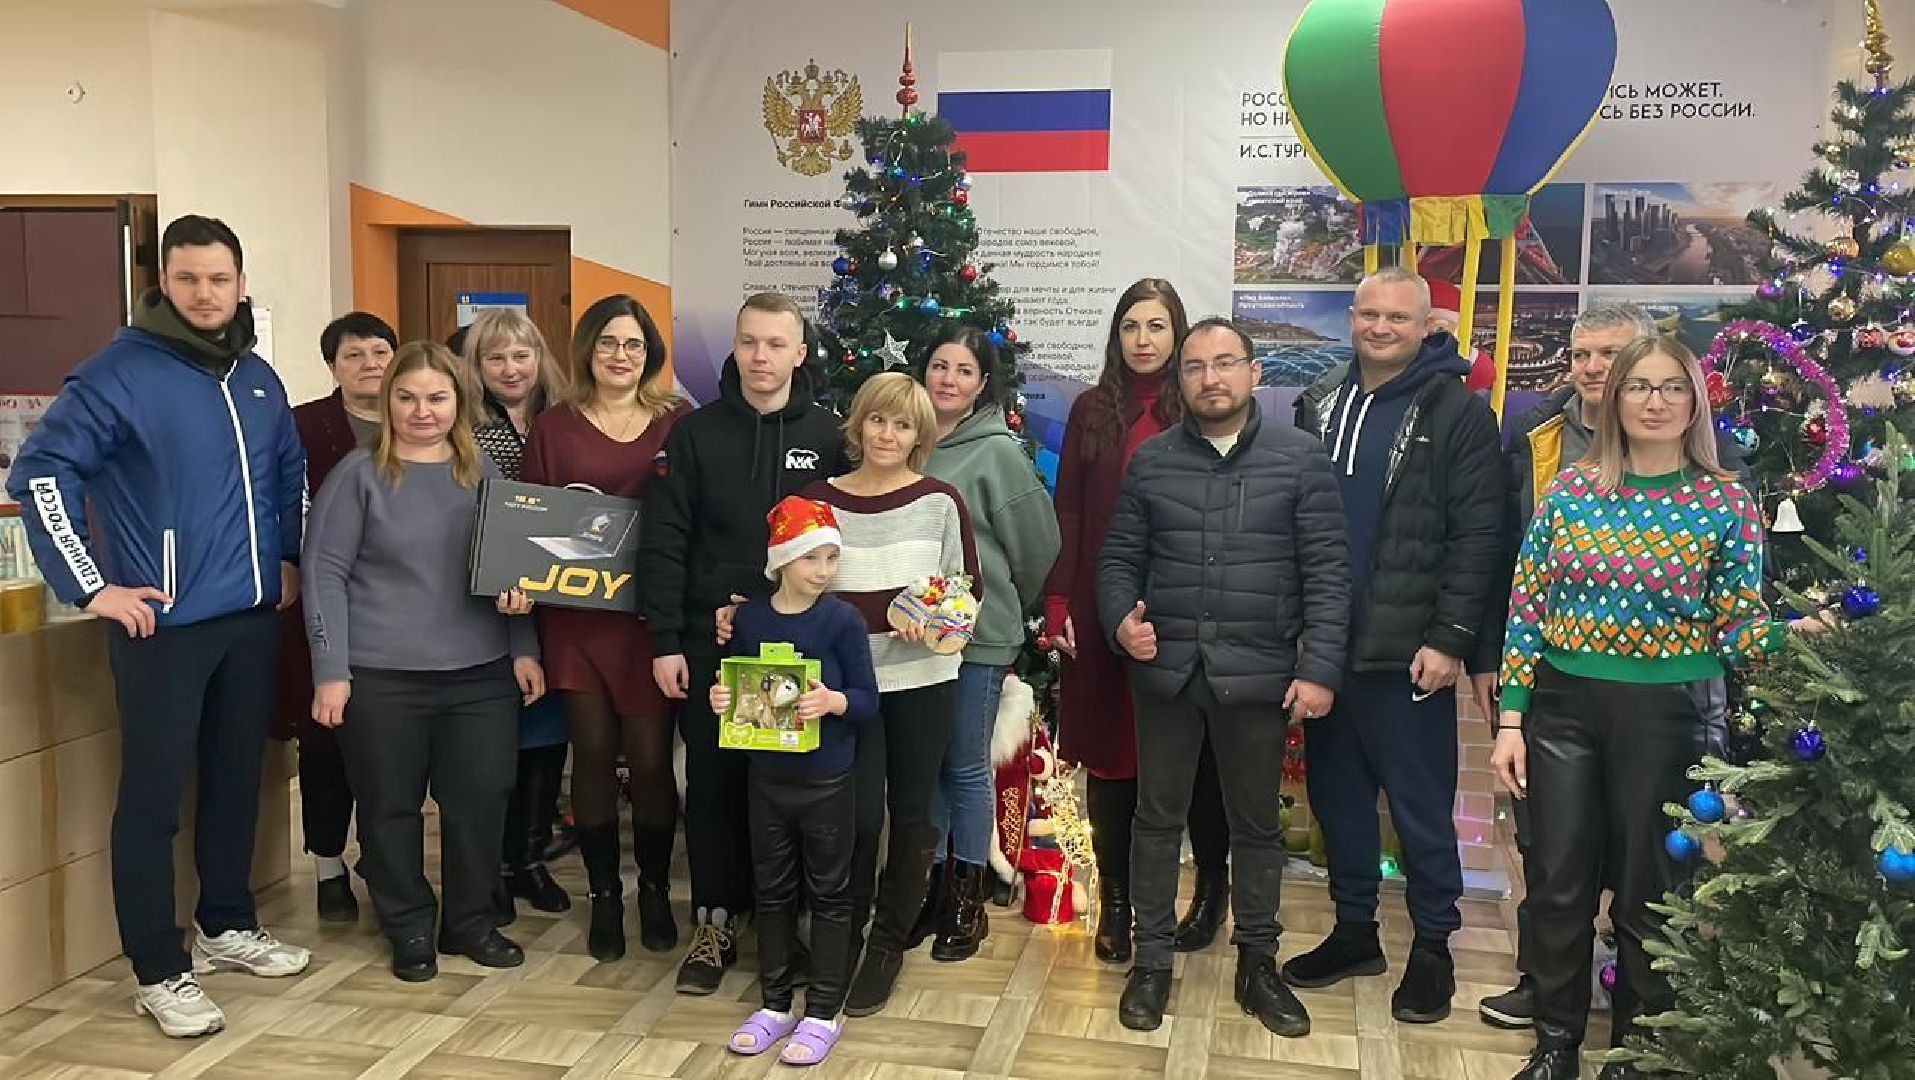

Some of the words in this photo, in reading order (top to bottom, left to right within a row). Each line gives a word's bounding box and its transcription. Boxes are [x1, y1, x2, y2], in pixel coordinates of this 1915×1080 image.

[1242, 93, 1286, 107] РОСС
[1629, 104, 1664, 119] БЕЗ
[1670, 103, 1755, 119] РОССИИ.
[1241, 112, 1267, 126] НО
[1240, 143, 1306, 158] И.С.ТУР
[744, 199, 769, 208] Гимн
[770, 199, 831, 208] Российской
[36, 482, 65, 532] РОССИЯ
[59, 534, 98, 587] ЕДИНАЯ
[519, 564, 632, 600] JOY
